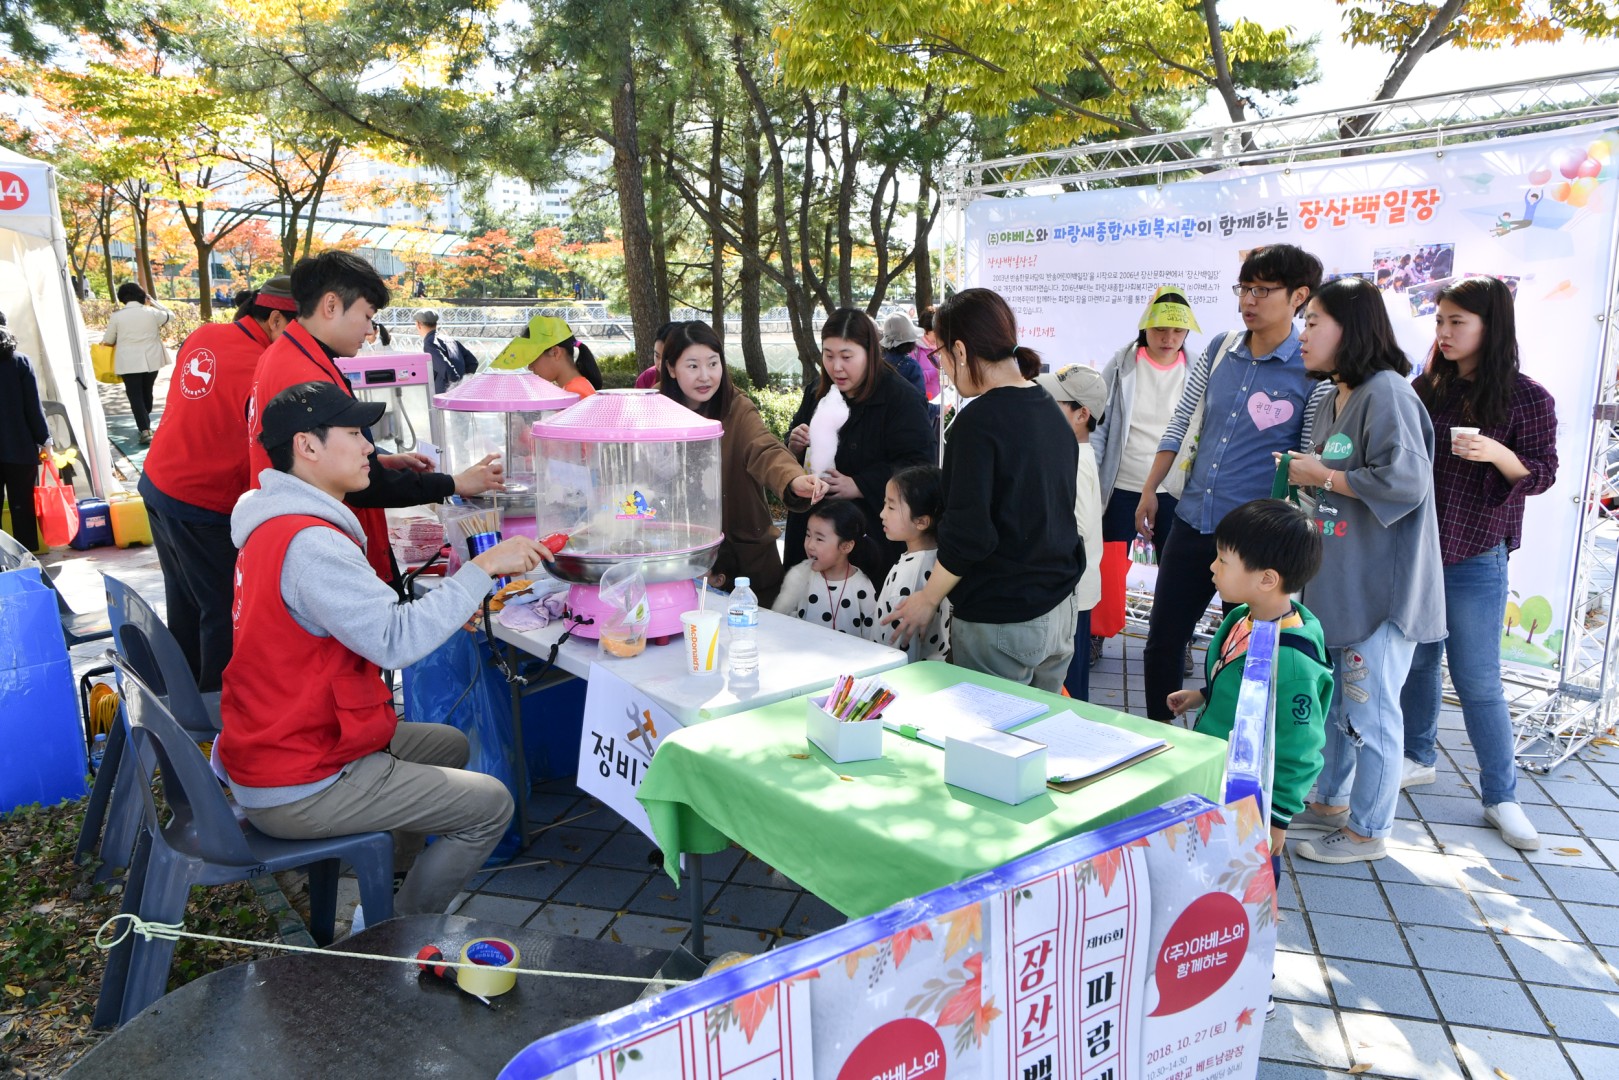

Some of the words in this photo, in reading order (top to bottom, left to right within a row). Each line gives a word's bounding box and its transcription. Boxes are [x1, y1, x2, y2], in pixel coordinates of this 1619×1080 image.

[987, 228, 1048, 246] (주)야베스와
[1053, 216, 1212, 243] 파랑새종합사회복지관이
[1219, 206, 1289, 236] 함께하는
[1298, 188, 1441, 230] 장산백일장
[987, 254, 1038, 269] 장산백일장은?
[1096, 270, 1118, 280] 시작으로
[1119, 270, 1140, 280] 2006년
[1028, 326, 1056, 338] 이모저모
[689, 623, 699, 671] McDonald's
[1292, 693, 1312, 720] 3
[1086, 927, 1124, 950] 제16회
[1163, 922, 1245, 963] (주)야베스와
[1176, 951, 1228, 979] 함께하는
[1146, 1043, 1173, 1065] 2018.
[1177, 1035, 1192, 1051] 10.
[1194, 1028, 1208, 1044] 27
[1209, 1021, 1227, 1039] (토)
[1195, 1044, 1244, 1072] 베트남광장
